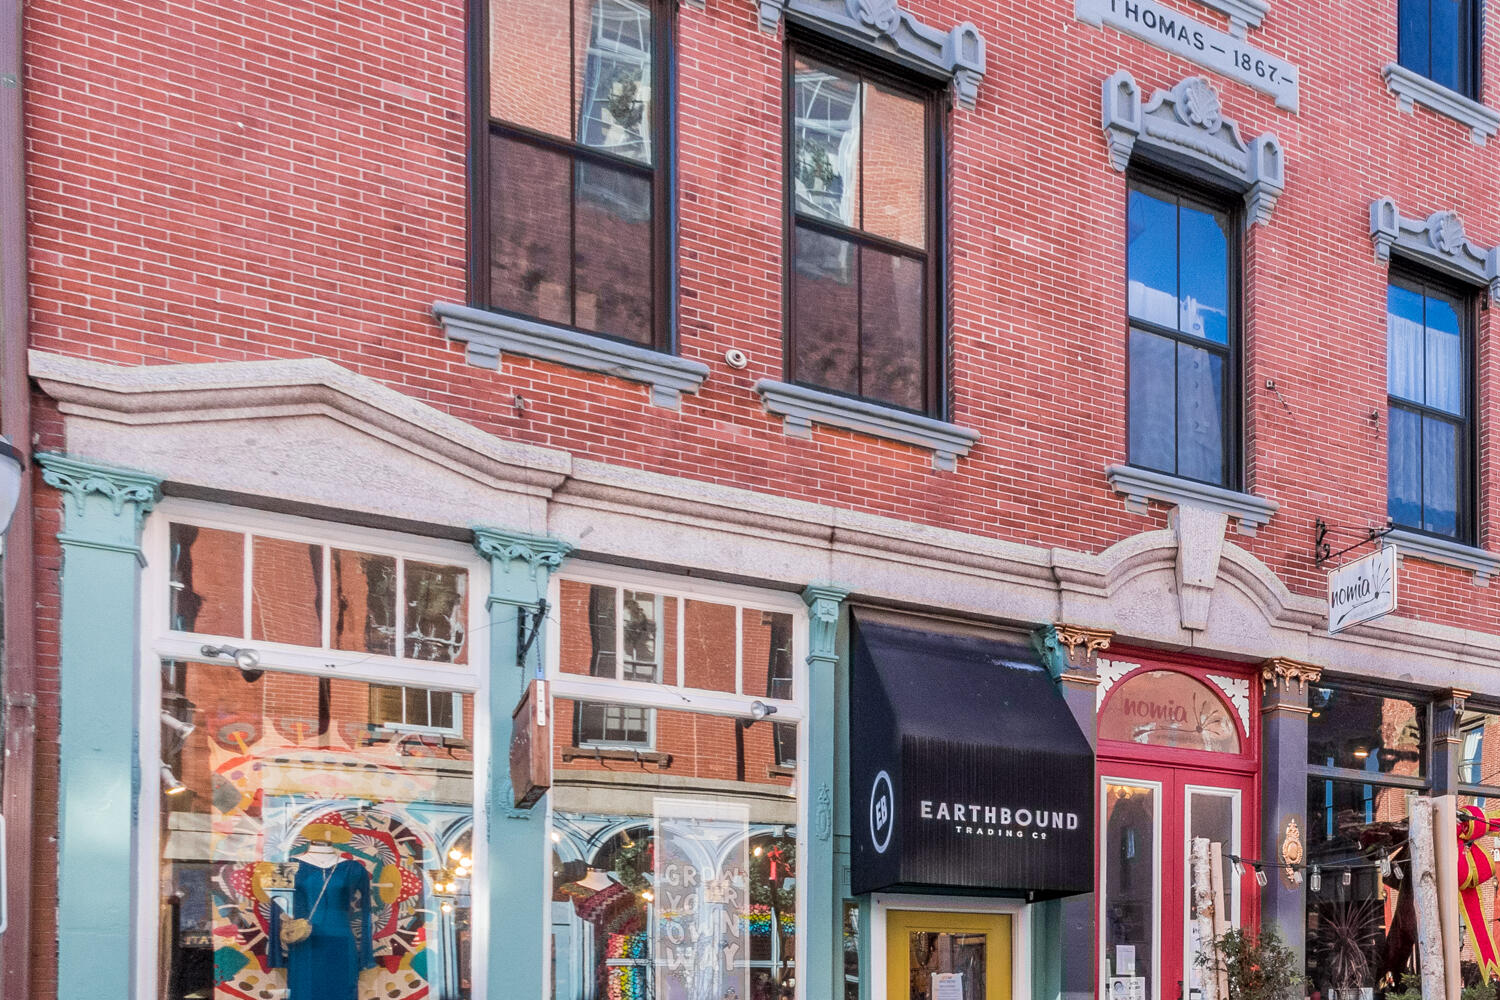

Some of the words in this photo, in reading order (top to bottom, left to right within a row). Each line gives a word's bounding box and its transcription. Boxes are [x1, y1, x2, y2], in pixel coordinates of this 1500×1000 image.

[1331, 576, 1371, 609] nomia
[1123, 698, 1188, 723] nomia
[875, 795, 888, 831] EB
[920, 800, 1079, 830] EARTHBOUND
[956, 826, 1024, 838] TRADING
